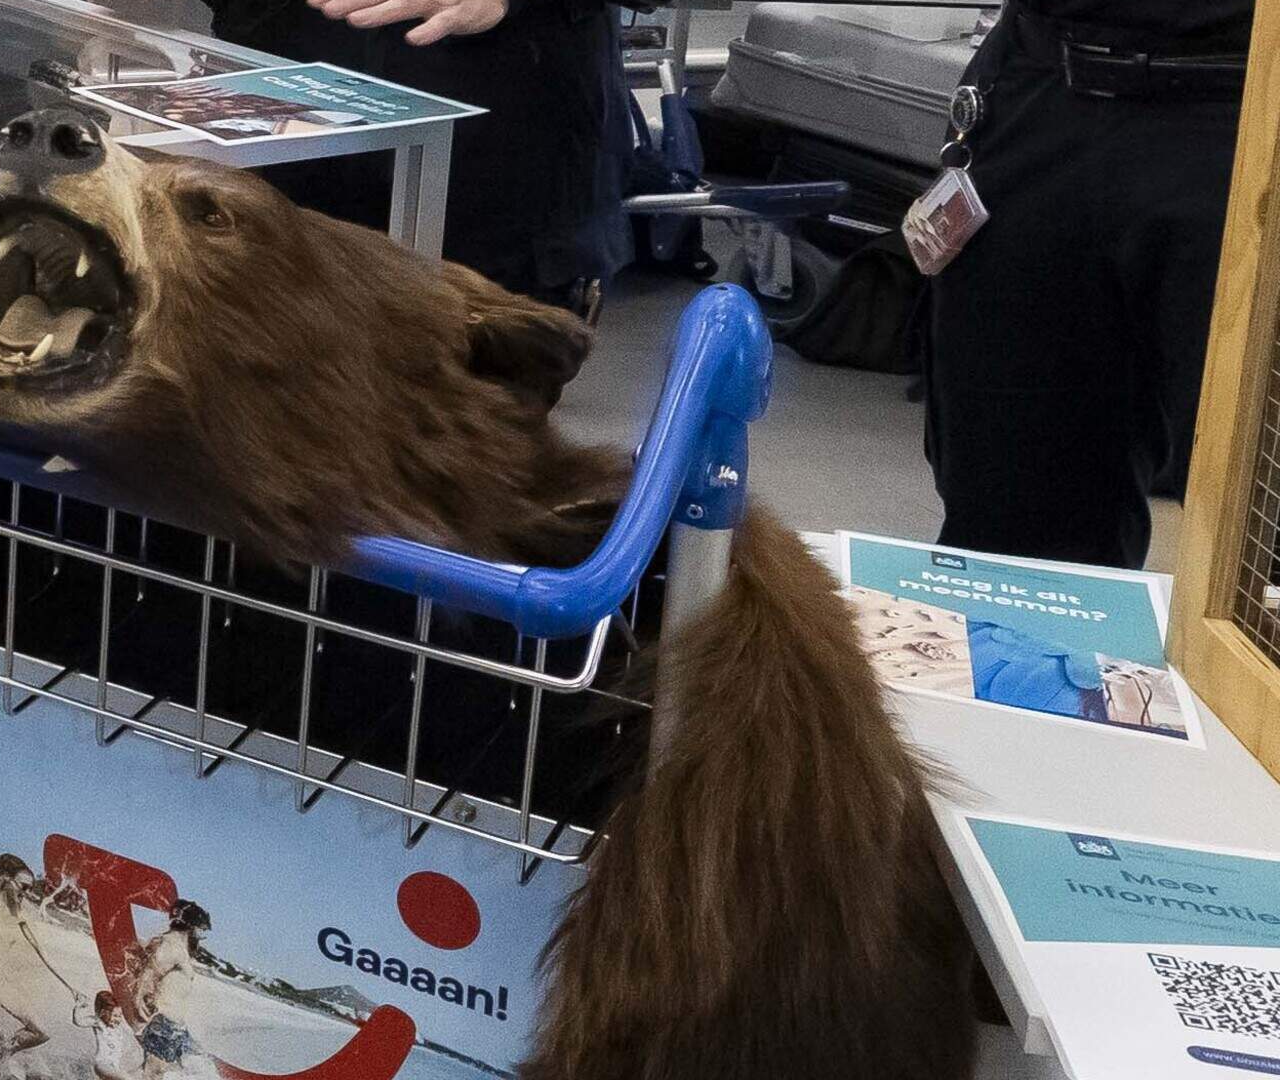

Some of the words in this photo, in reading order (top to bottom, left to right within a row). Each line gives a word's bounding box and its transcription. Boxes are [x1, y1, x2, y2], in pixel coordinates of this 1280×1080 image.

[899, 579, 1108, 622] meenemen?
[921, 571, 993, 593] Mag
[1000, 582, 1030, 597] ik
[1035, 590, 1082, 606] dit
[1065, 878, 1280, 925] informatie
[1120, 870, 1219, 896] Meer
[316, 926, 509, 1021] Gaaaan!
